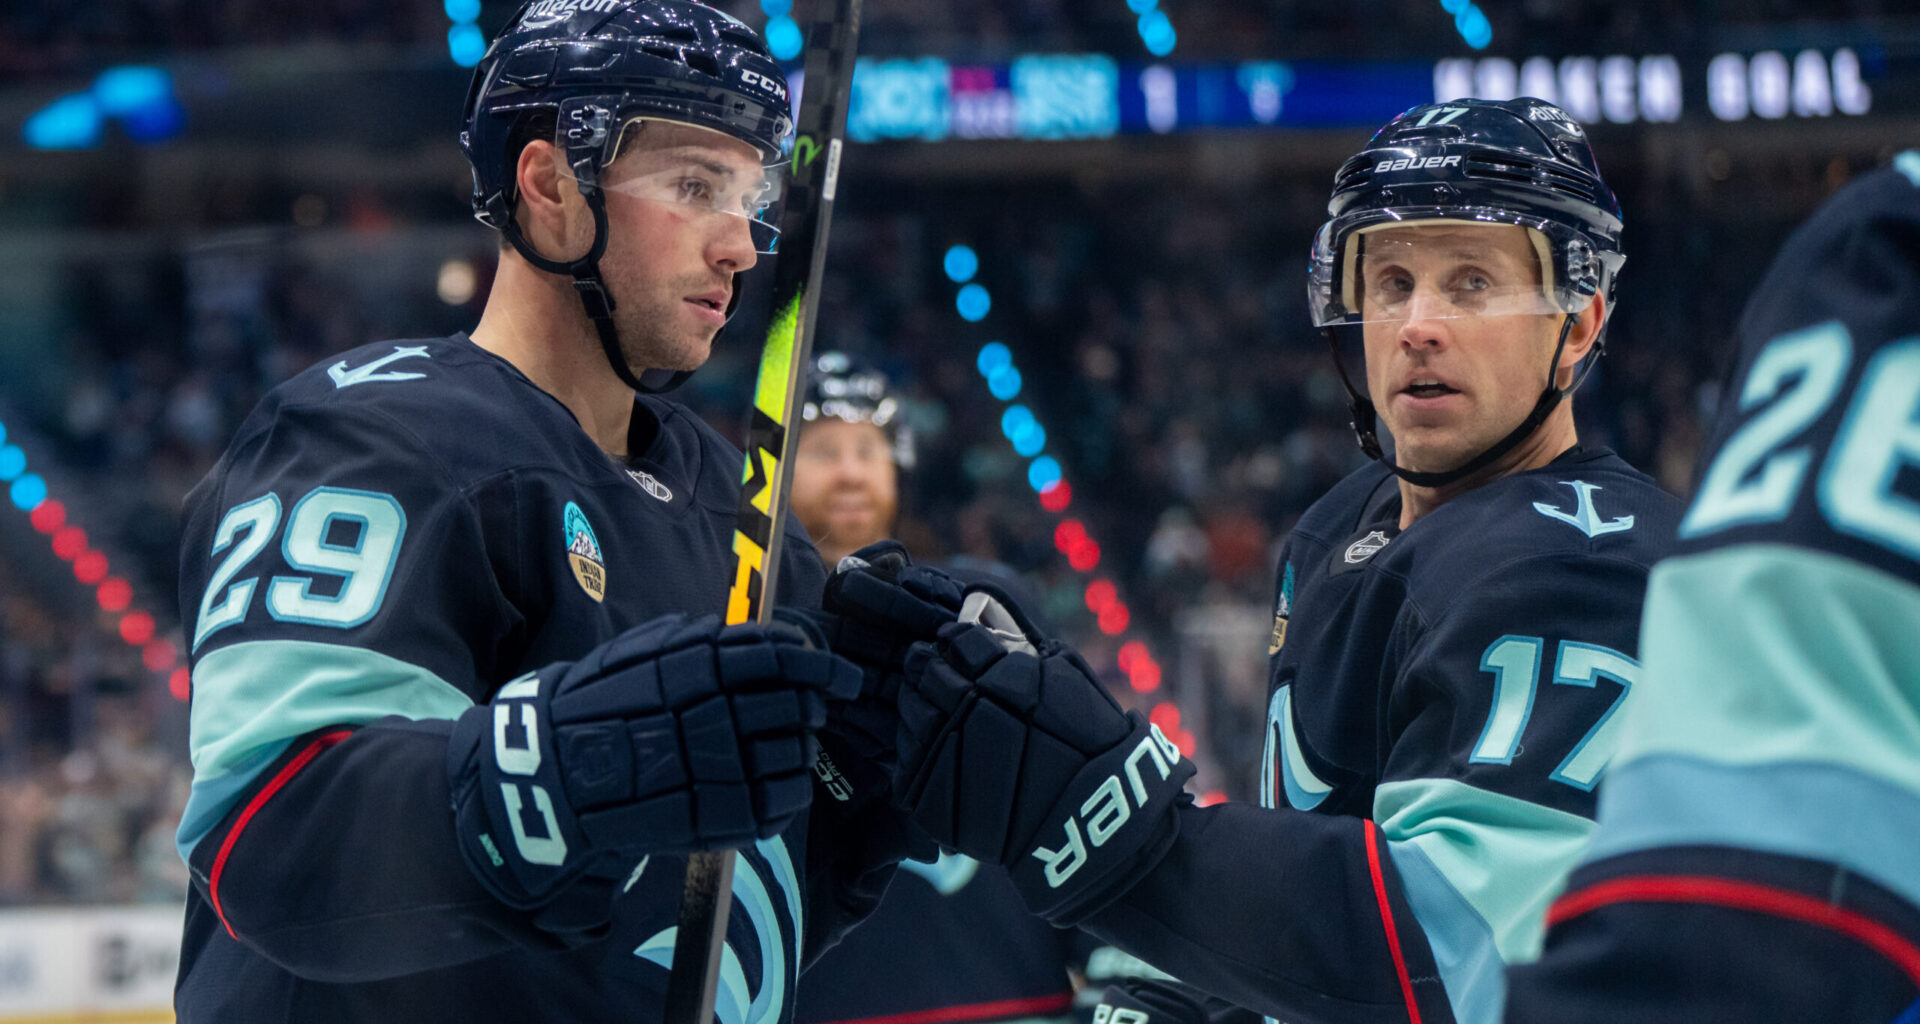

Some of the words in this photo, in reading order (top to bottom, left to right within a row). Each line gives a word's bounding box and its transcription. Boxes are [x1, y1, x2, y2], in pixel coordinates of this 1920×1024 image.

[741, 69, 786, 101] CCM
[1417, 107, 1470, 127] 17
[1374, 155, 1462, 174] BAUER
[1676, 319, 1920, 561] 26
[192, 486, 408, 655] 29
[1468, 634, 1642, 793] 17
[815, 761, 850, 801] CC
[1031, 721, 1181, 889] AUER
